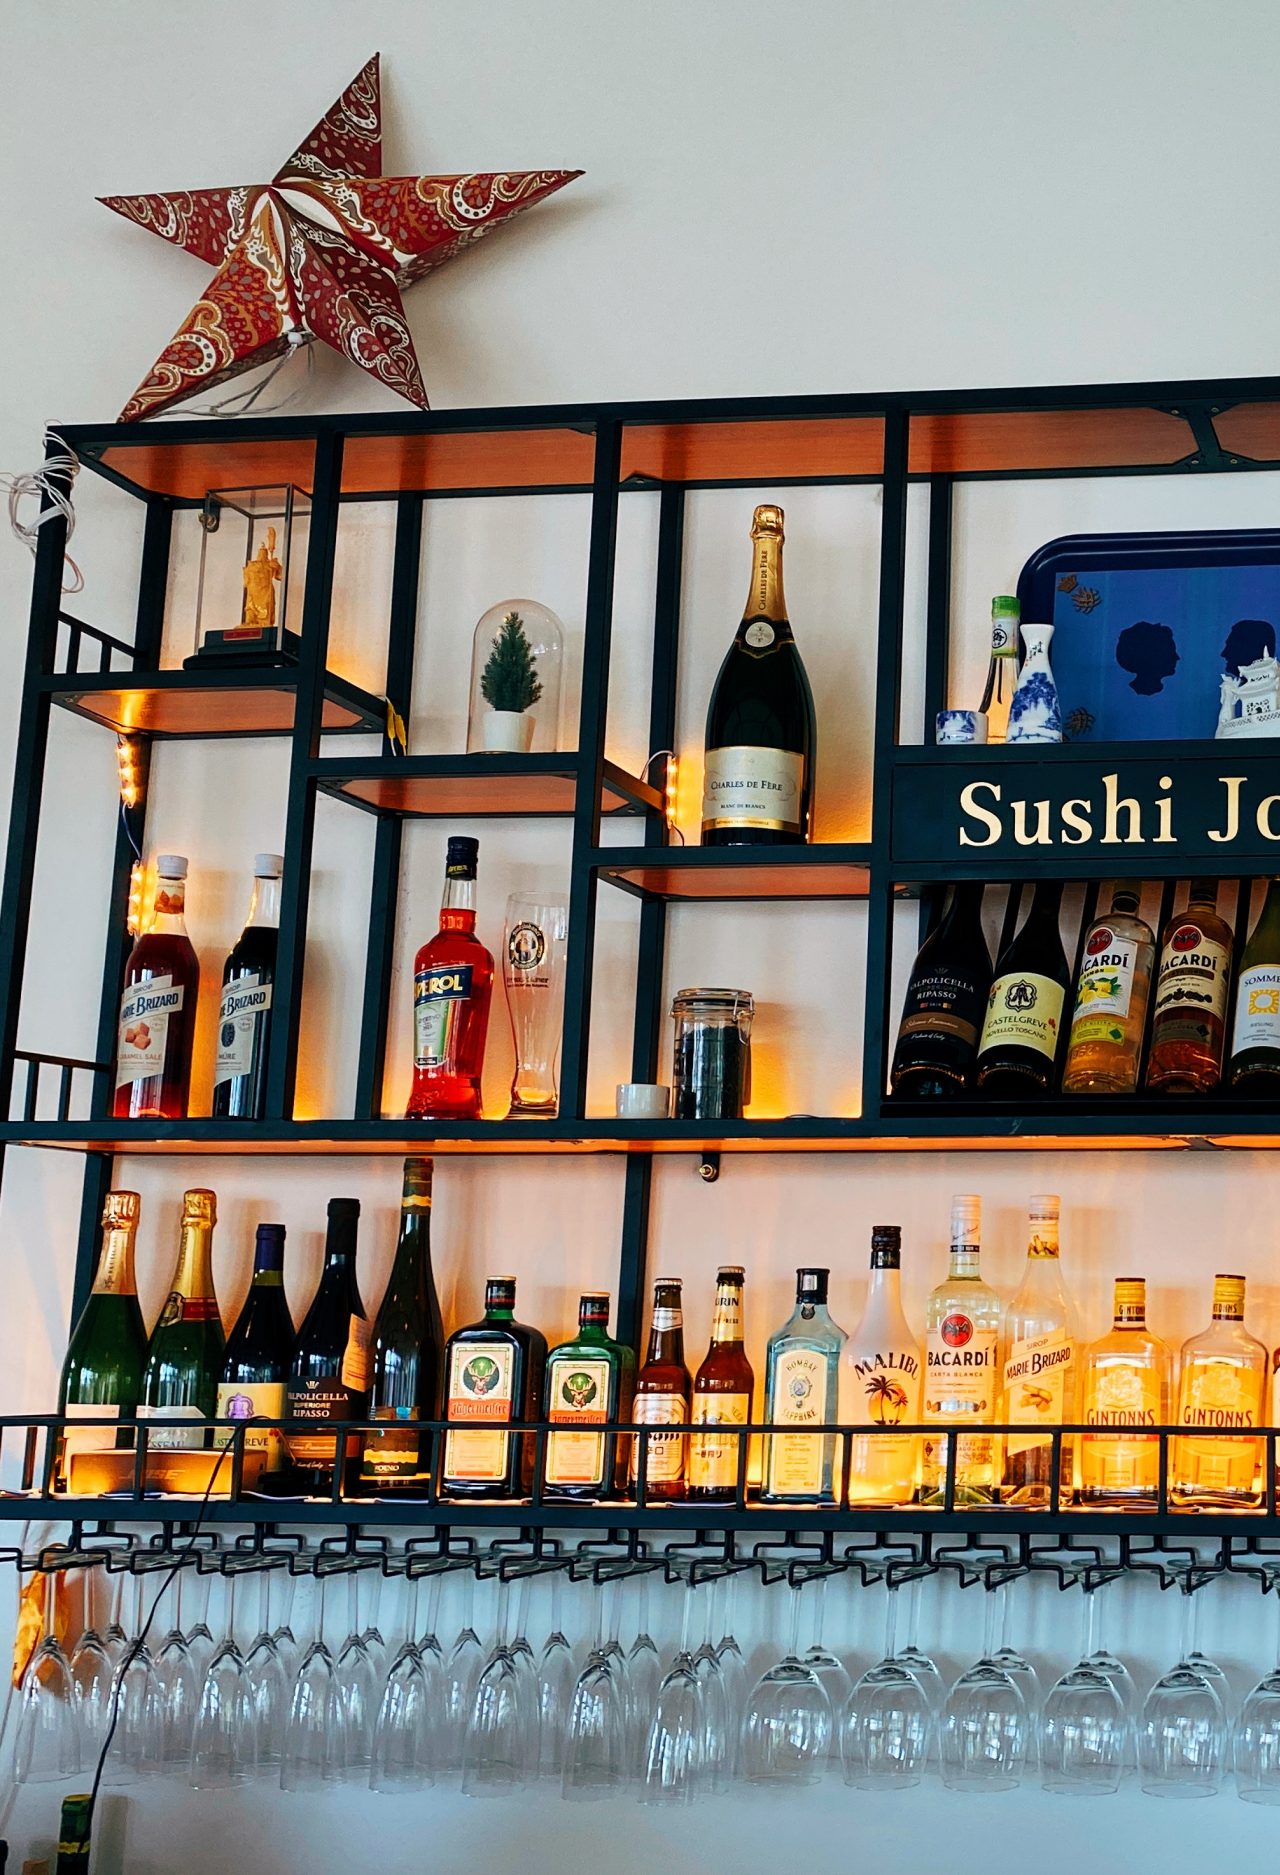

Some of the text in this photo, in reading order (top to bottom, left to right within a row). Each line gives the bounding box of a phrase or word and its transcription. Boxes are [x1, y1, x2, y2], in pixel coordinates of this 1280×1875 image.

[710, 780, 744, 790] CHARLES
[746, 781, 758, 789] DE
[959, 773, 1178, 847] Sushi
[415, 974, 463, 999] PEROL
[916, 990, 957, 1000] RIPASSO
[136, 993, 179, 1016] BRIZARD
[226, 992, 266, 1017] BRIZARD
[987, 1016, 1048, 1031] CASTELGREVE
[1015, 1027, 1047, 1041] TOSCANO
[1026, 1338, 1049, 1351] SIROP
[785, 1360, 818, 1372] BOMBAY
[928, 1347, 989, 1367] BACARDÍ
[1006, 1347, 1071, 1380] MARIE BRIZARD
[293, 1409, 330, 1418] RIPASSO
[1087, 1408, 1155, 1427] GINTONNS
[1183, 1405, 1253, 1427] GINTONNS
